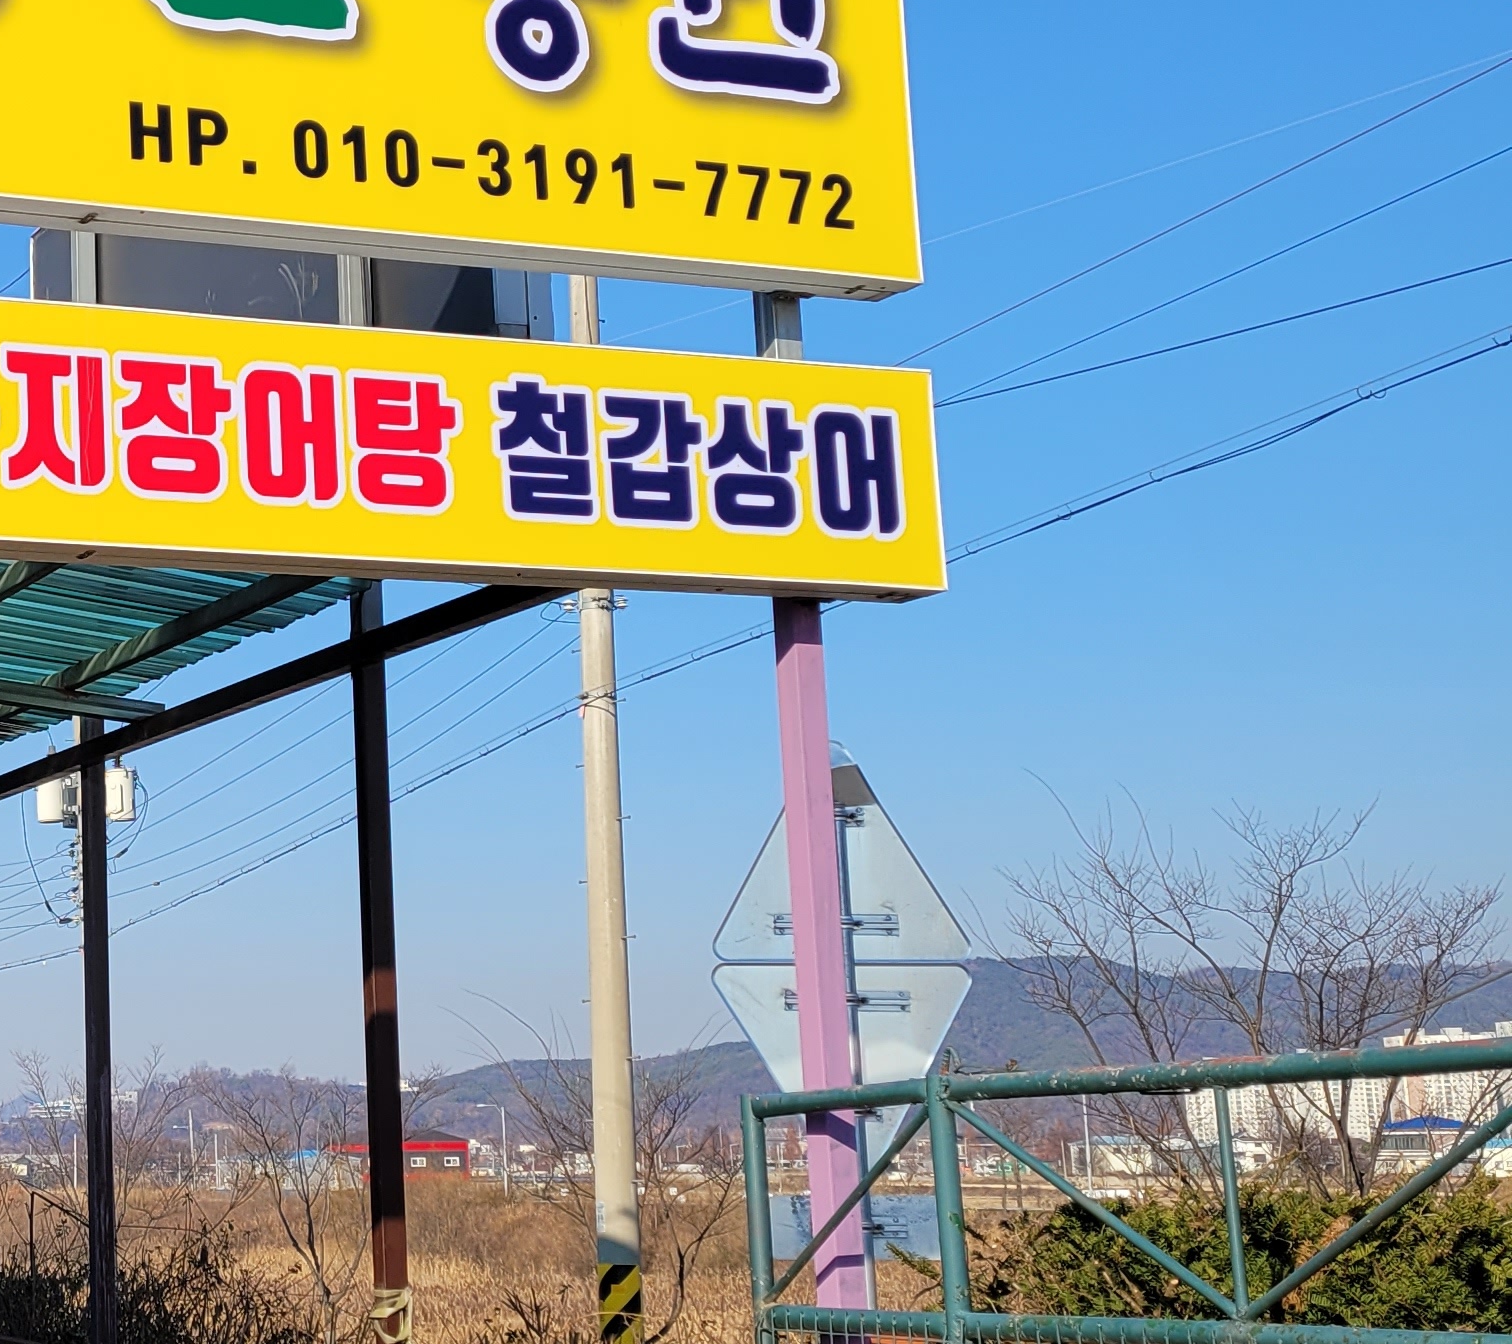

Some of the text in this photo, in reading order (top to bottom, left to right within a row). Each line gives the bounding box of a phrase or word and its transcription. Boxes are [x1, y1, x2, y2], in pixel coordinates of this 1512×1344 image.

[128, 100, 856, 230] HP. 010-3191-7772
[489, 373, 905, 541] 철갑상어
